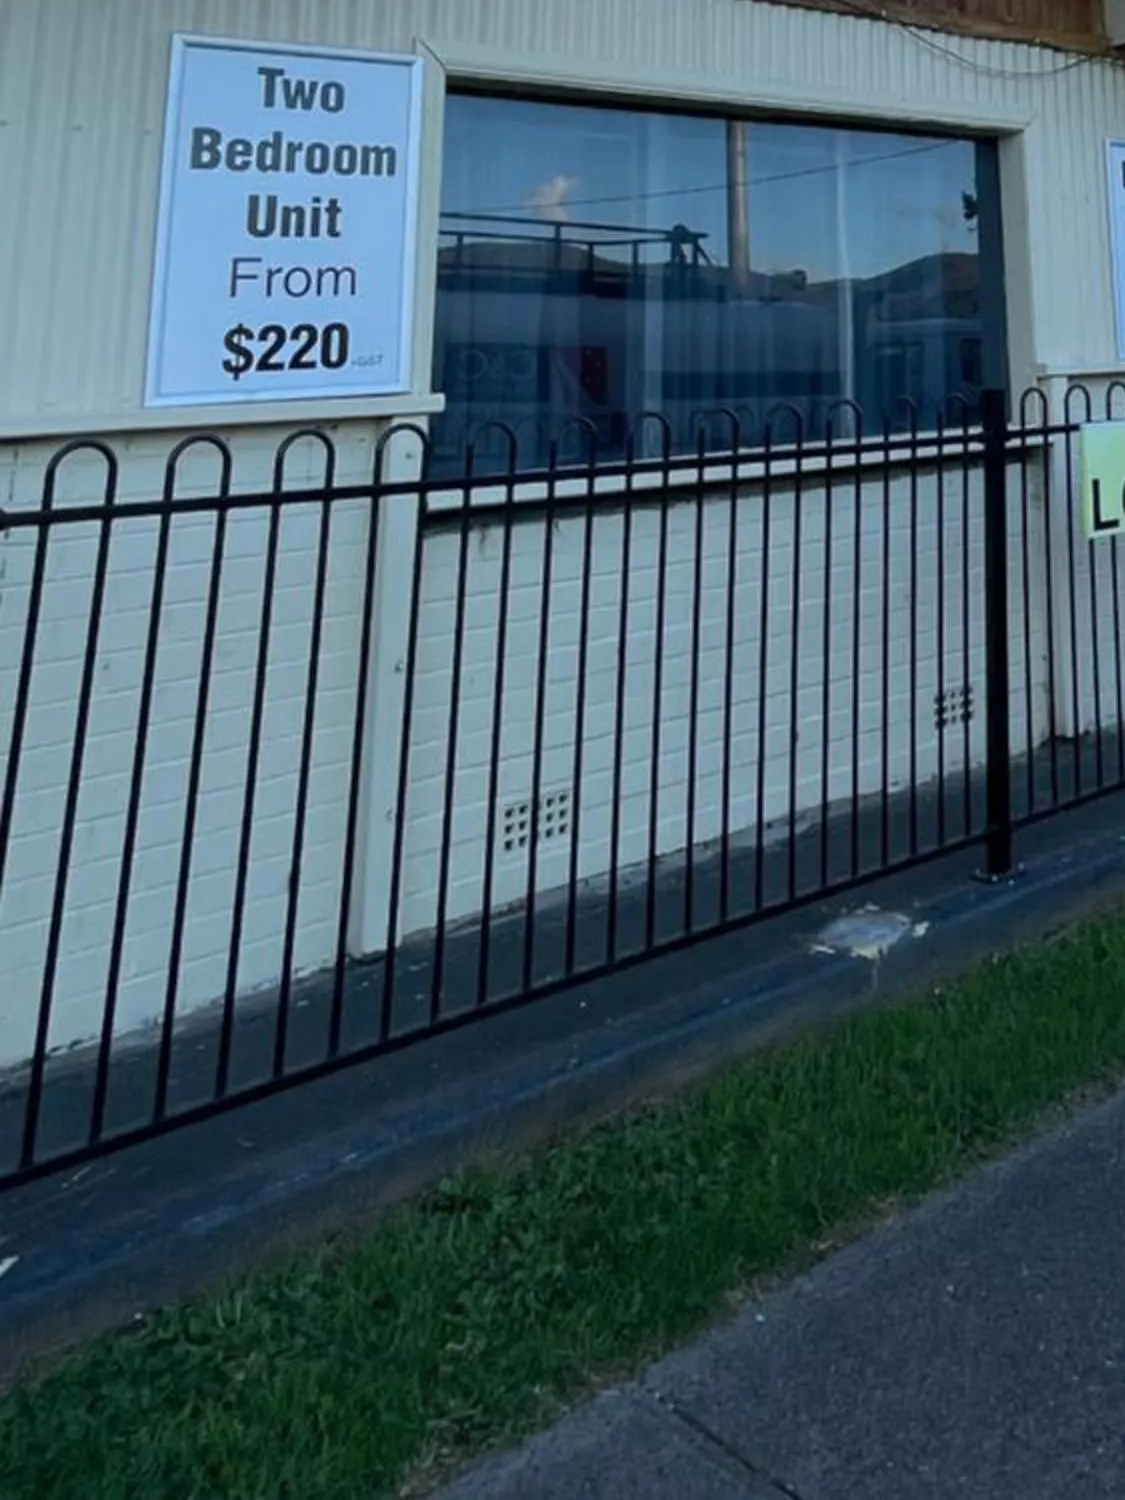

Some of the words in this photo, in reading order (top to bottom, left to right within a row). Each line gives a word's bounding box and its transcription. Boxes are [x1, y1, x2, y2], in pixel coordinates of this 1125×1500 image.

[257, 67, 345, 113] Two
[190, 127, 397, 177] Bedroom
[246, 194, 343, 238] Unit
[229, 257, 357, 298] From
[221, 322, 350, 381] $220
